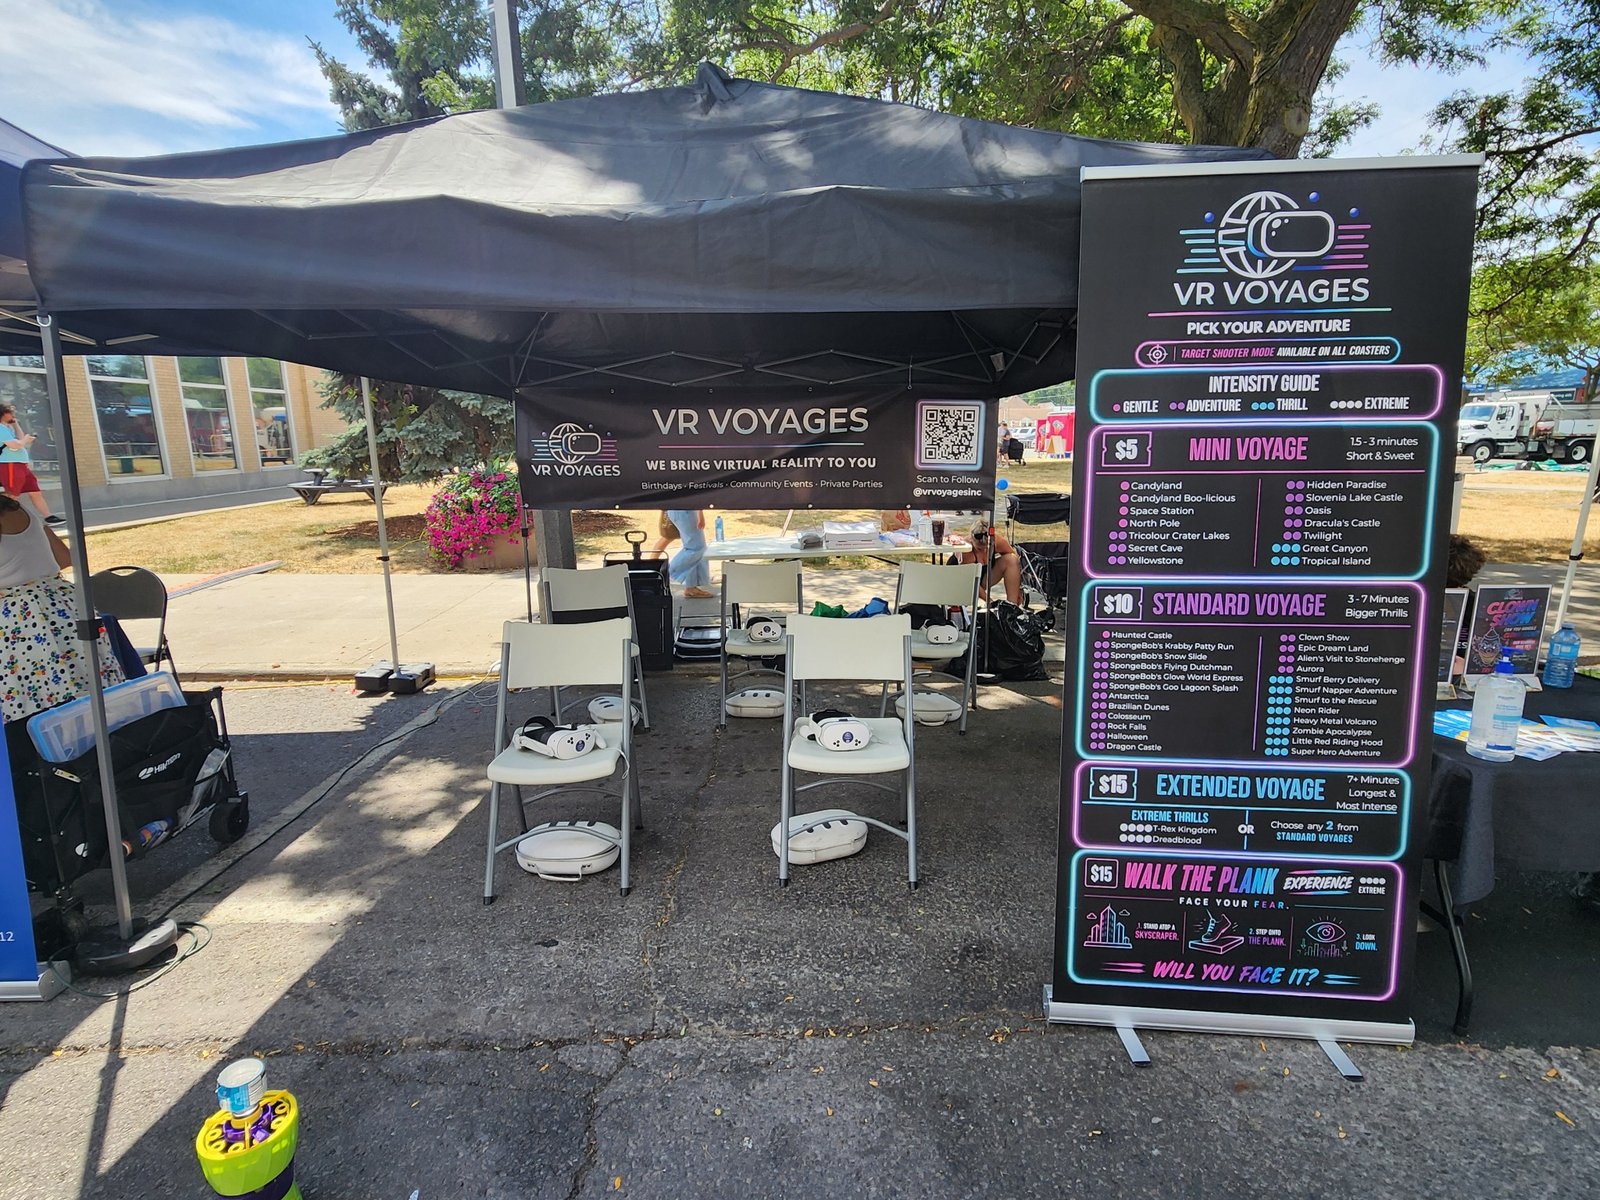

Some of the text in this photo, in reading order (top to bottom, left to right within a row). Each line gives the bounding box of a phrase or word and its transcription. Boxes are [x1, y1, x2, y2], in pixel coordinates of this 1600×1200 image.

[1174, 278, 1370, 305] VR VOYAGES
[1187, 318, 1351, 335] PICK YOUR ADVENTURE
[1181, 345, 1390, 359] TARGET SHOOTER MODE AVAILABLE ON ALL COASTERS
[1209, 375, 1320, 393] INTENSITY GUIDE
[1123, 398, 1409, 414] GENTLE ADVENTURE THRILL EXTREME
[652, 408, 869, 435] VR VOYAGES
[1115, 439, 1138, 460] $5
[1190, 437, 1308, 460] MINI VOYAGE
[1346, 452, 1414, 460] Short & Sweet
[646, 458, 876, 470] WE BRING VIRTUAL REALITY TO YOU
[532, 465, 620, 476] VR VOYAGES
[730, 480, 782, 489] Community
[853, 480, 883, 488] Parties
[1131, 482, 1182, 491] Candyland
[913, 488, 981, 497] @vrvoyagesinc
[1130, 494, 1181, 504] Candyland
[1130, 507, 1158, 516] Space
[1303, 532, 1342, 541] Twilight
[1332, 544, 1368, 554] Canyon
[1128, 556, 1183, 564] Yellowstone
[1302, 557, 1340, 566] Tropical
[1104, 594, 1133, 614] $10
[1153, 593, 1326, 616] STANDARD VOYAGE
[1346, 609, 1408, 618] Bigger Thrills
[1299, 645, 1316, 653] Epic
[1355, 656, 1405, 665] Stonehenge
[1324, 676, 1345, 685] Berry
[1348, 677, 1380, 685] Delivery
[1326, 728, 1372, 737] Apocalypse
[1099, 774, 1128, 794] $15
[1347, 776, 1400, 785] 7+ Minutes
[1157, 774, 1325, 800] EXTENDED VOYAGE
[1349, 789, 1386, 798] Longest
[1362, 802, 1397, 811] Intense
[1132, 810, 1209, 823] EXTREME THRILLS
[1178, 825, 1216, 835] Kingdom
[1238, 824, 1254, 834] OR
[1271, 821, 1358, 832] Choose any 2 from
[1153, 836, 1201, 844] Dreadblood
[1276, 832, 1352, 843] STANDARD VOYAGES
[1090, 864, 1112, 882] $15
[1124, 863, 1279, 894] WALK THE PLANK
[1283, 877, 1354, 890] EXPERIENCE
[1358, 886, 1386, 894] EXTREME
[1179, 897, 1209, 906] FACE
[1216, 899, 1247, 908] YOUR
[1153, 960, 1319, 986] WILL YOU FACE IT?
